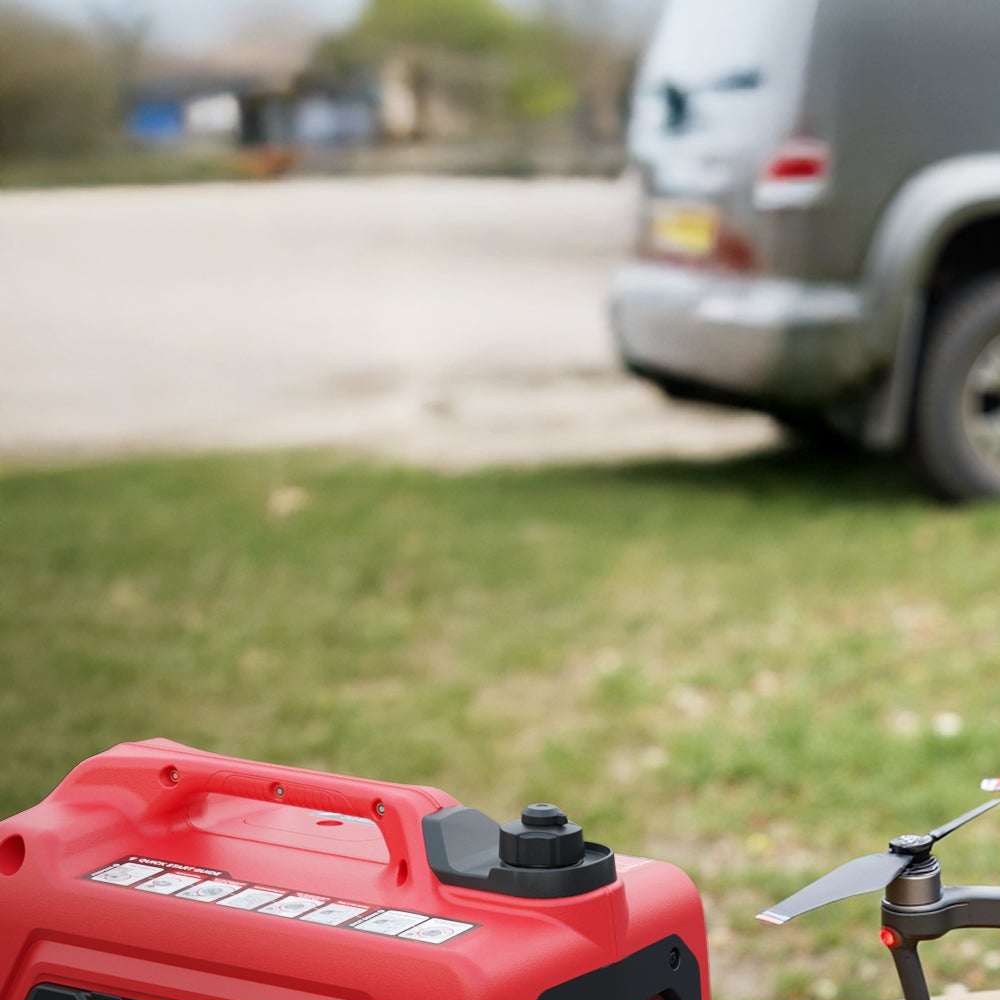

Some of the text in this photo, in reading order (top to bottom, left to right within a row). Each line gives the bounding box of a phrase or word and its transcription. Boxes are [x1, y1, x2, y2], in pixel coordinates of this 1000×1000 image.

[138, 858, 166, 867] QUICK
[166, 863, 195, 872] START
[194, 867, 223, 876] GUIDE
